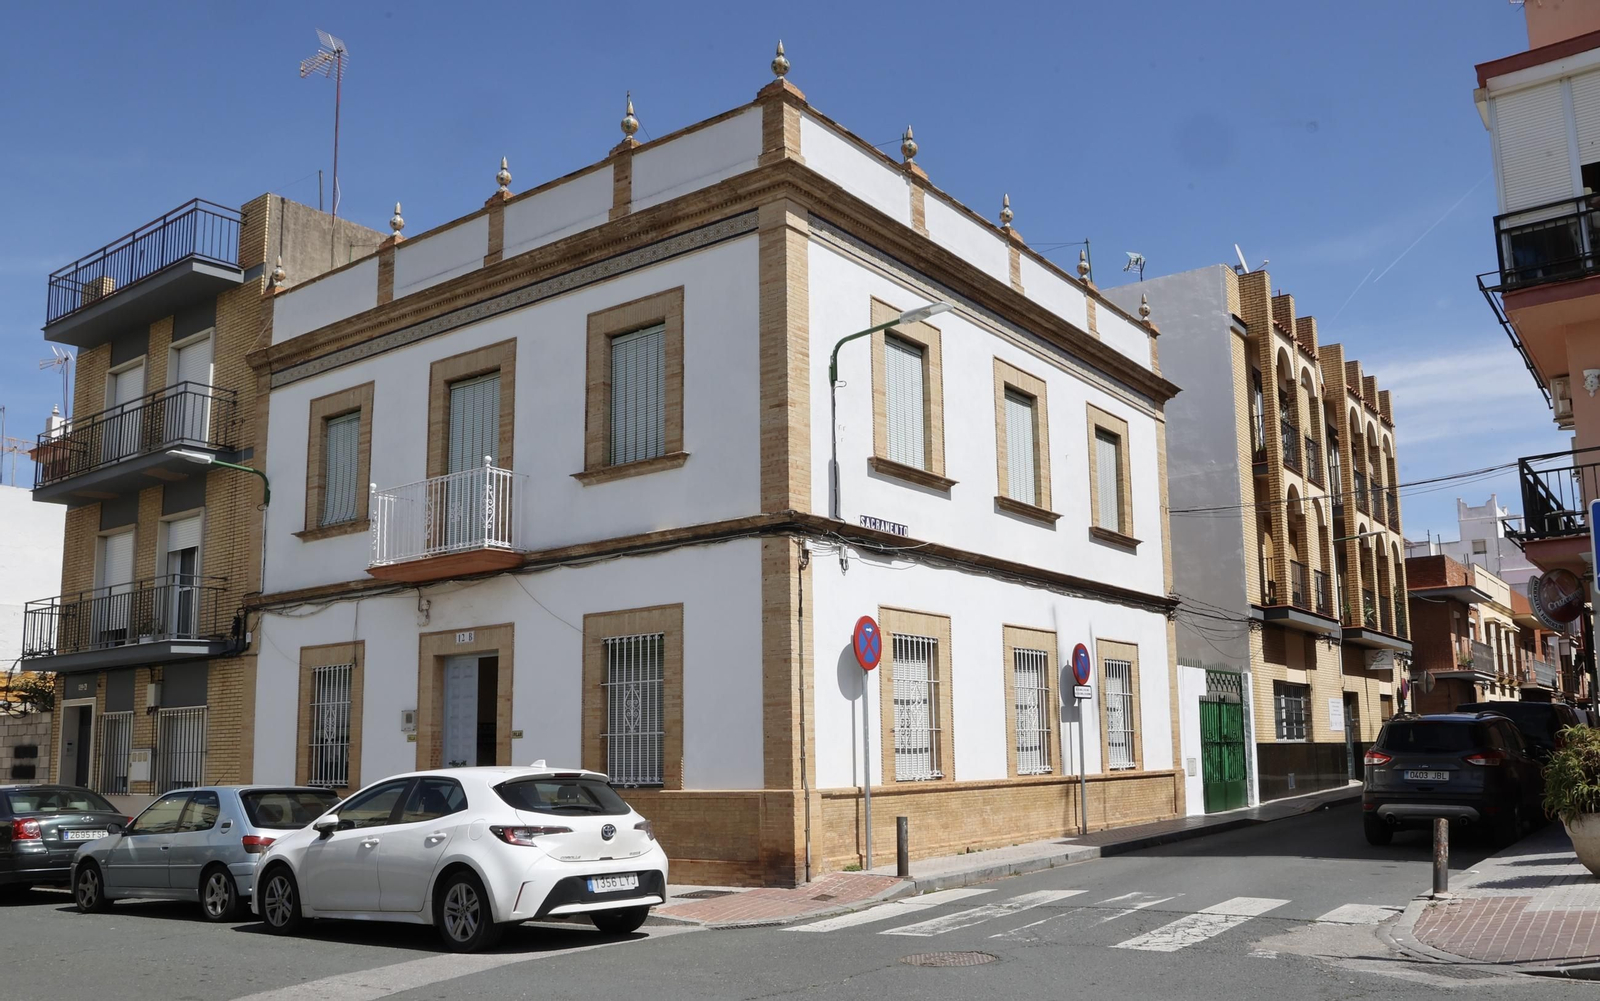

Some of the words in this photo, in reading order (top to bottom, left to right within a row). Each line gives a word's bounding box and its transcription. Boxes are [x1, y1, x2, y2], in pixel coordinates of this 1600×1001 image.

[860, 516, 908, 536] SACRAMENTO
[458, 633, 465, 642] 12
[468, 632, 473, 641] B
[1410, 771, 1428, 779] 0403
[1432, 772, 1447, 780] JBL
[70, 831, 91, 839] 2695
[595, 876, 617, 889] 1356
[619, 874, 636, 887] LYJ
